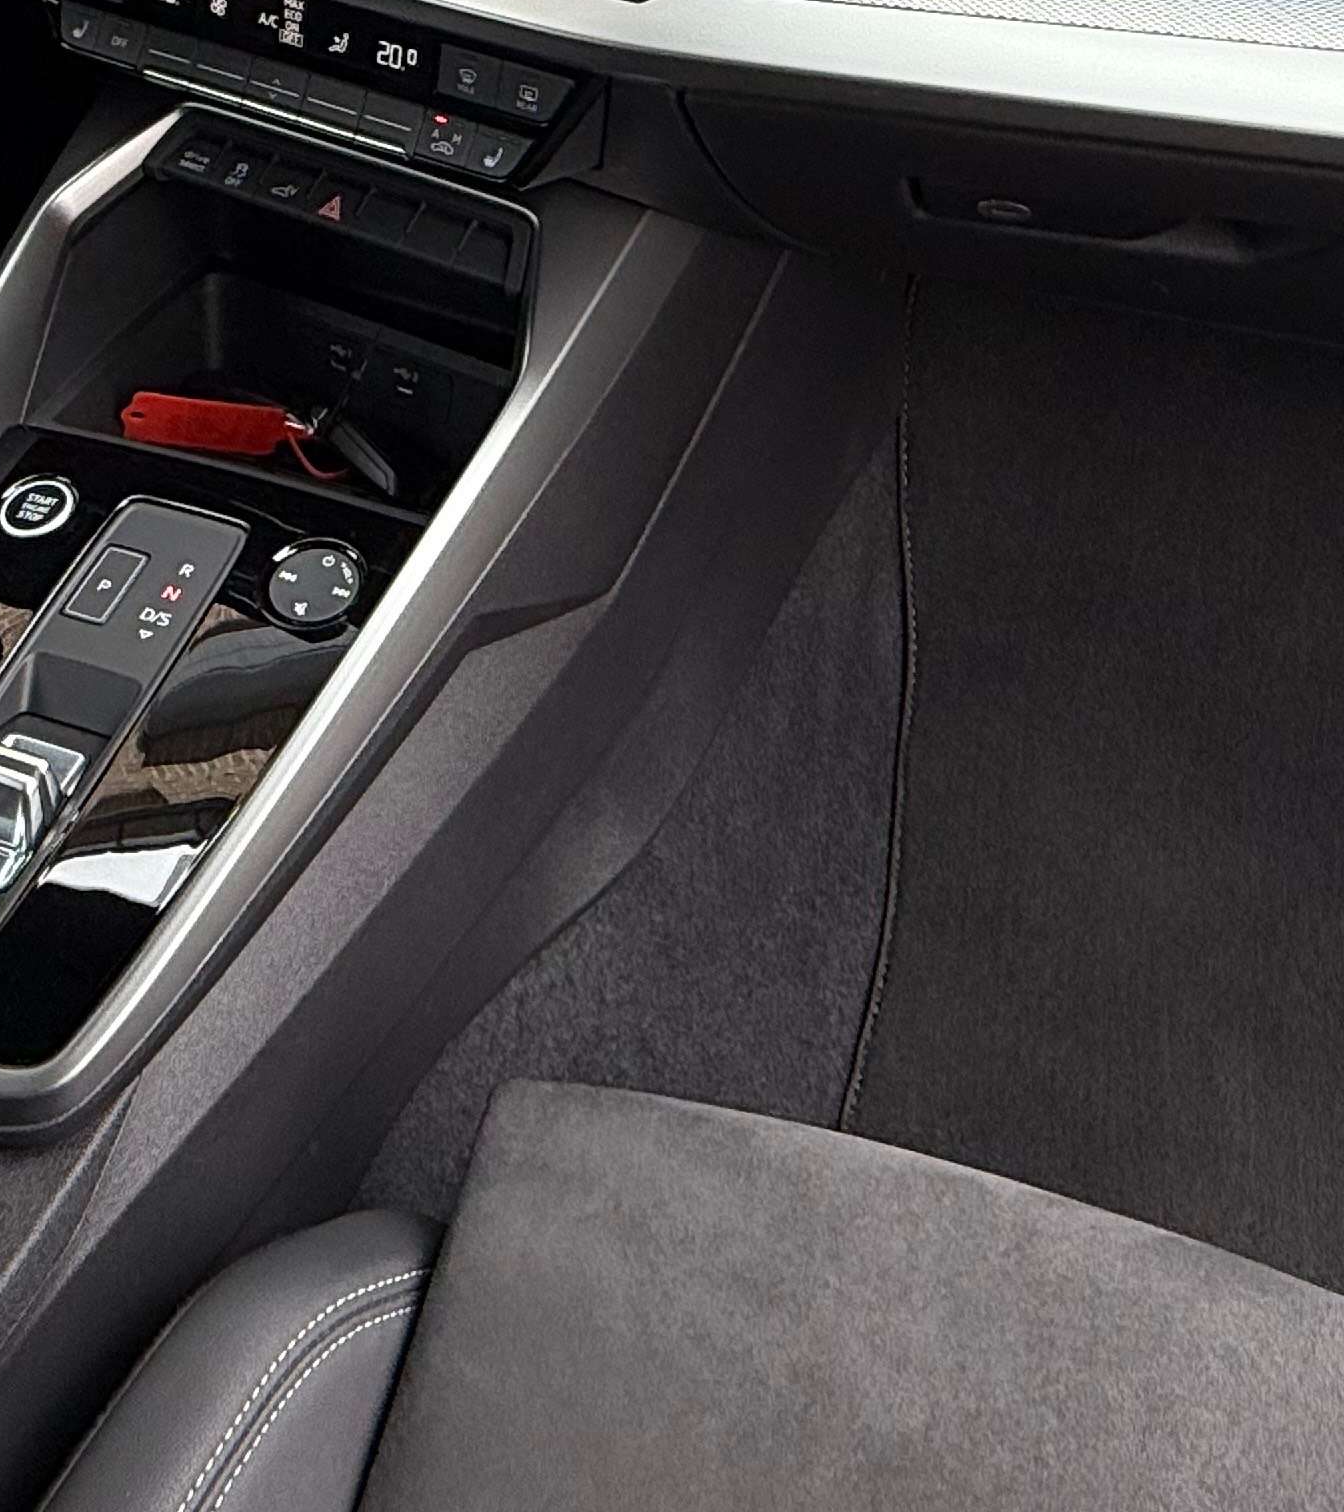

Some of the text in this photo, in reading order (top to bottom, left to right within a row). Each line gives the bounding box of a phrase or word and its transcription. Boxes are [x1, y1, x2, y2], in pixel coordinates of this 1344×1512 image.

[257, 12, 279, 29] A/C
[26, 492, 59, 506] START
[16, 510, 45, 522] STOP
[179, 563, 194, 578] R
[96, 578, 112, 592] P
[160, 585, 181, 602] N
[139, 606, 172, 627] D/S
